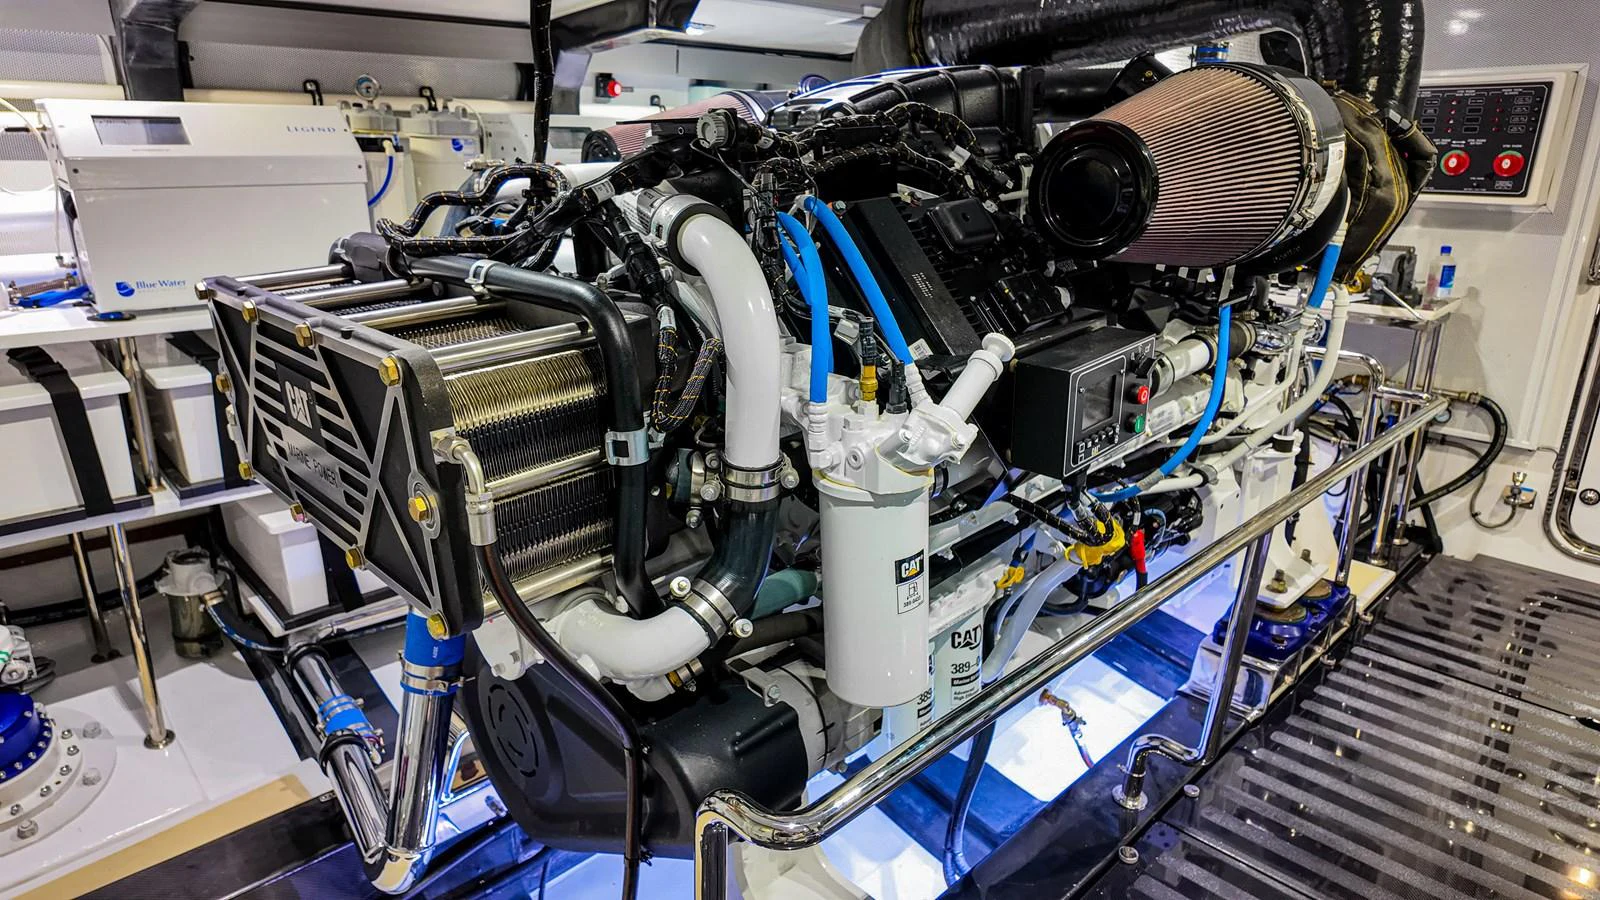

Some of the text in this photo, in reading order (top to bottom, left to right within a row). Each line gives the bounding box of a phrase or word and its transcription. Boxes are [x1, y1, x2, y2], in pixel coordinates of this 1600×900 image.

[136, 279, 186, 288] Blue Water
[285, 380, 313, 428] CAT
[286, 440, 339, 488] MARINE POWER
[901, 556, 921, 578] CAT
[951, 624, 981, 650] CAT
